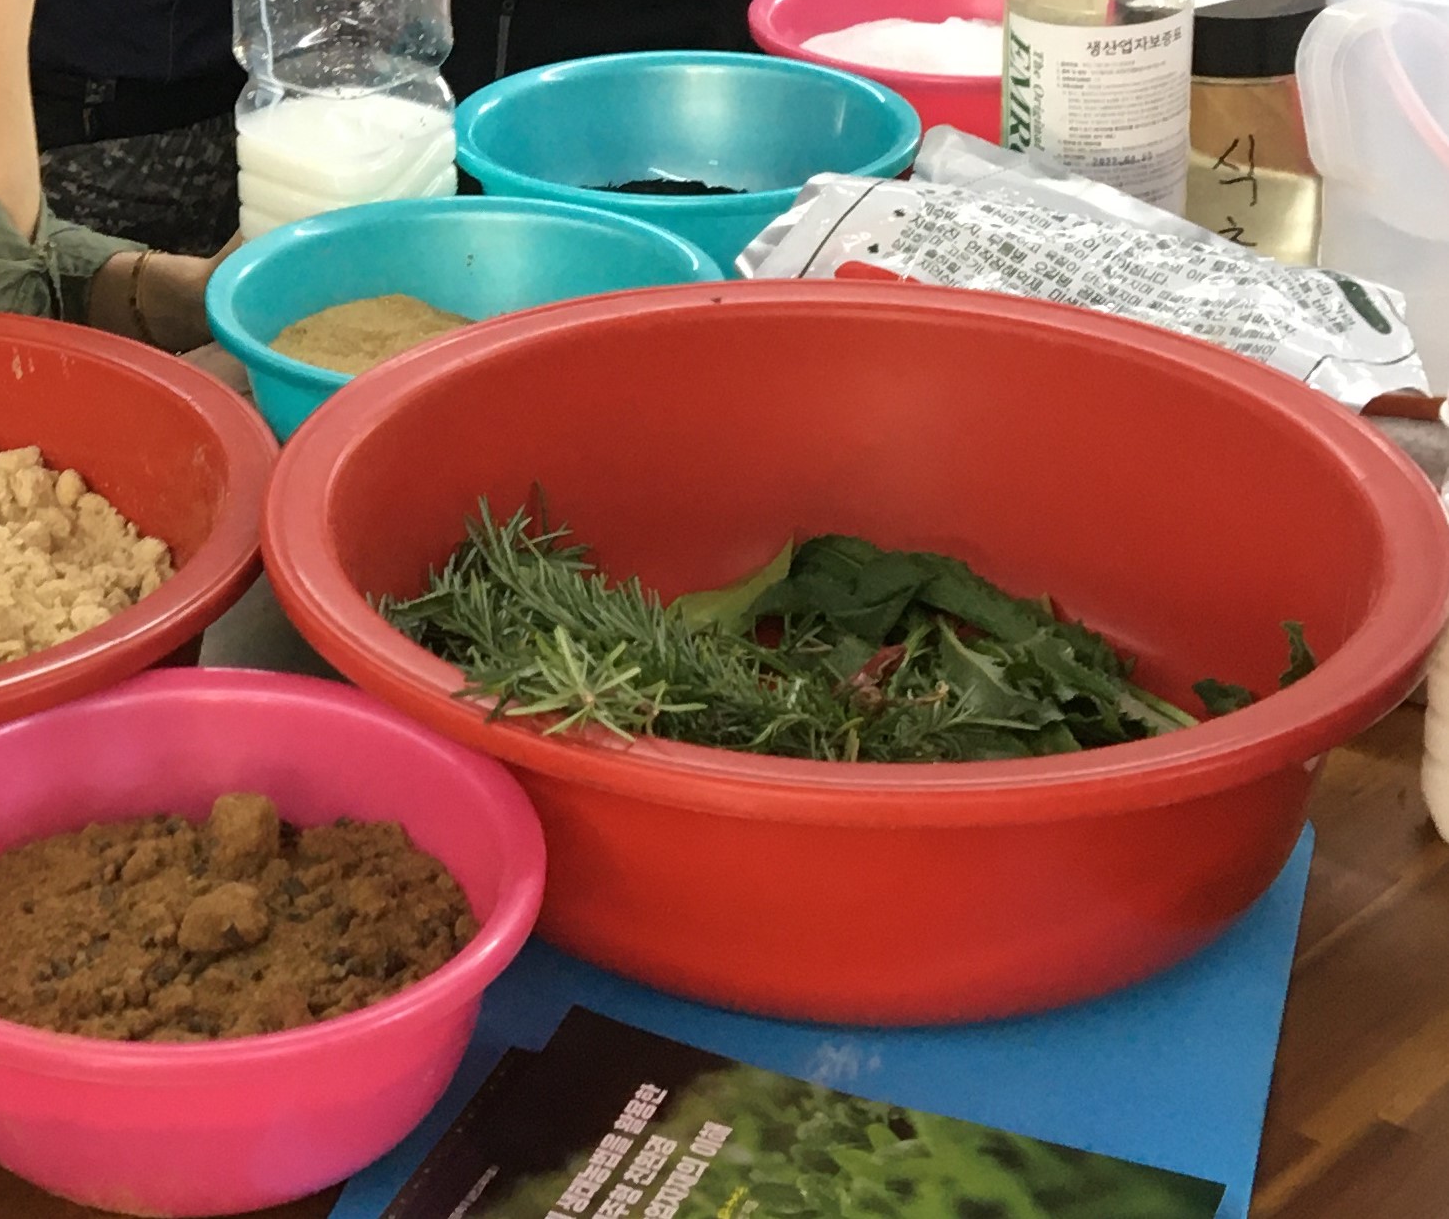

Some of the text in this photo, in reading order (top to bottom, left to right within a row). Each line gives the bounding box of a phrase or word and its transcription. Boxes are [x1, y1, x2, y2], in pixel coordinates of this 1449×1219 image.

[1086, 26, 1182, 57] 생산업자보증표
[1033, 50, 1045, 78] The
[555, 1132, 634, 1213] 생태농법을
[613, 1082, 669, 1135] 활용한
[689, 1120, 734, 1158] 이해
[622, 1134, 678, 1186] 친환경
